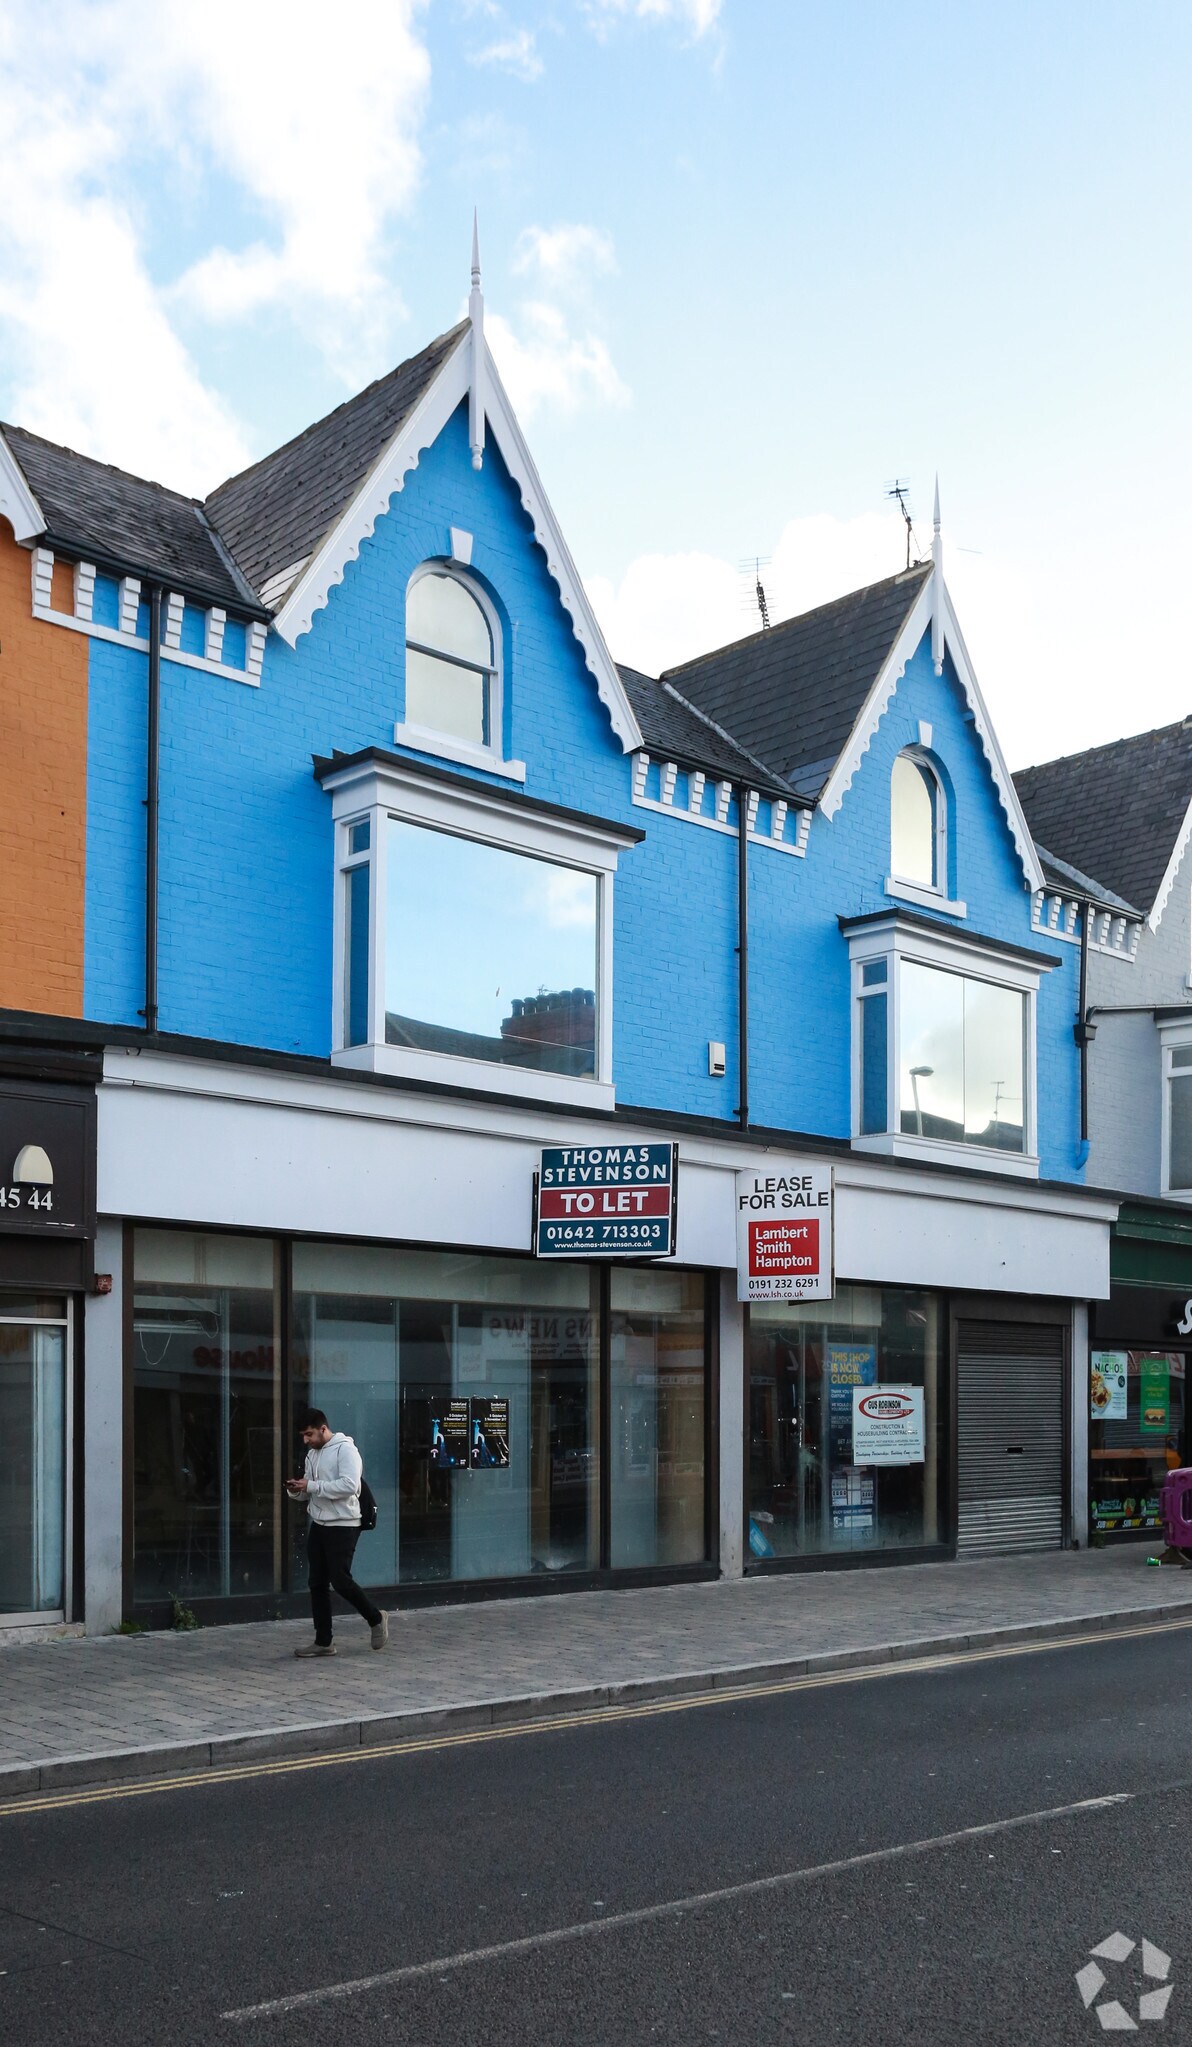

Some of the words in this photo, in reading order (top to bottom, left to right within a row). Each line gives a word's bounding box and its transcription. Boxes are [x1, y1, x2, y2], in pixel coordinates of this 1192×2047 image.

[561, 1147, 650, 1165] THOMAS
[544, 1164, 667, 1183] STEVENSON
[754, 1176, 813, 1193] LEASE
[27, 1189, 53, 1211] 44
[560, 1193, 594, 1213] TO
[602, 1191, 649, 1212] LET
[739, 1195, 775, 1210] FOR
[781, 1191, 829, 1209] SALE
[547, 1226, 594, 1239] 01642
[602, 1224, 661, 1238] 713303
[755, 1225, 808, 1240] Lambert
[554, 1240, 652, 1249] www.thomas-stevenson.co.uk
[756, 1242, 791, 1253] Smith
[755, 1254, 812, 1268] Hampton
[748, 1279, 771, 1290] 0191
[775, 1279, 793, 1289] 232
[796, 1278, 819, 1288] 6291
[749, 1290, 804, 1299] www.lsh.co.uk
[831, 1352, 848, 1362] THIS
[831, 1363, 839, 1373] IS
[1094, 1363, 1124, 1374] NACHOS
[868, 1400, 878, 1409] GUS
[878, 1400, 902, 1409] ROBINSON
